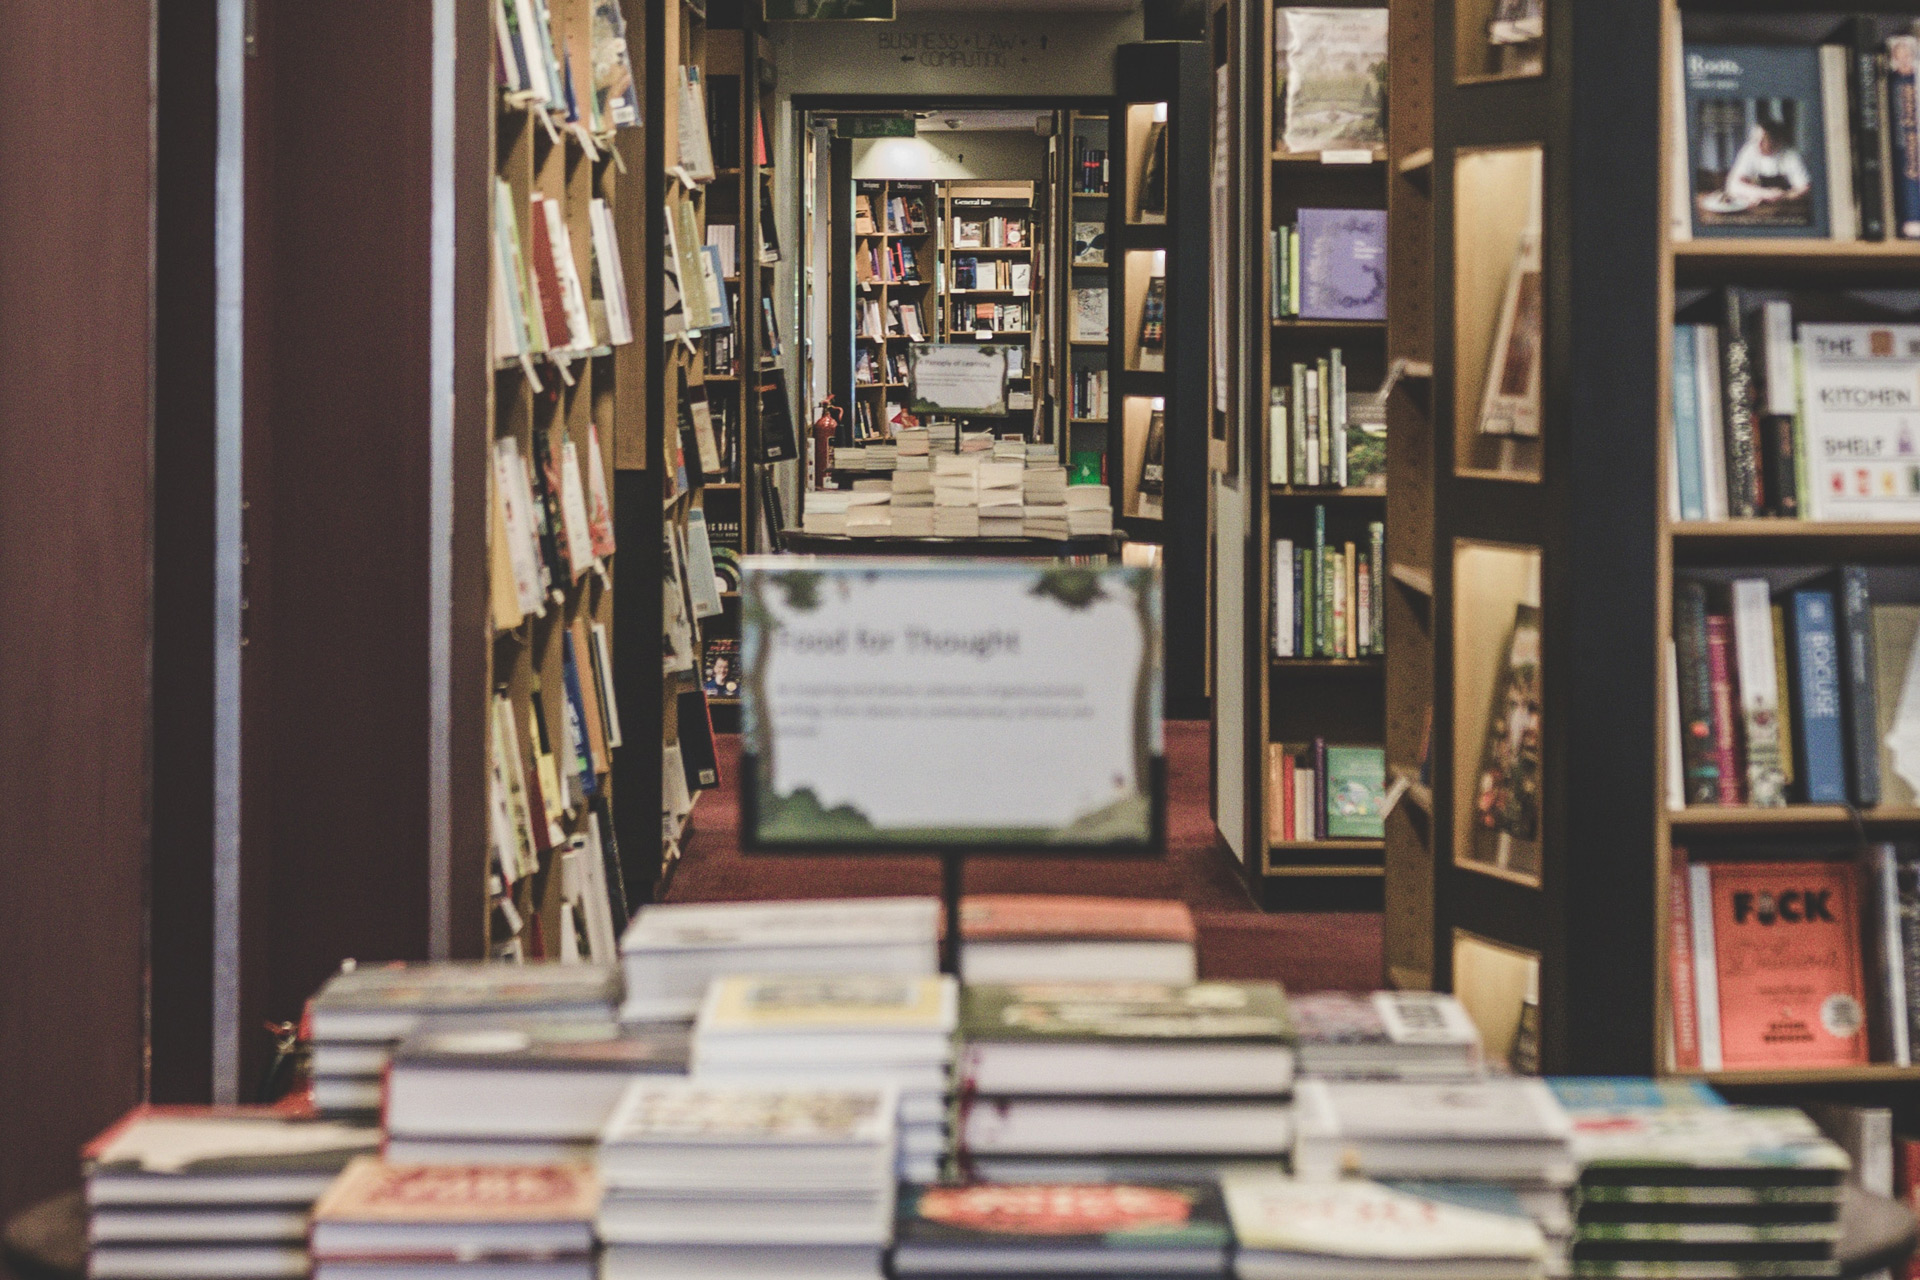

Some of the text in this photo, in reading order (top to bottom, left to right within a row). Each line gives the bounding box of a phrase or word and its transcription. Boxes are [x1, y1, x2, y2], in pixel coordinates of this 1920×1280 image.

[878, 31, 1018, 50] BUSINESS LAW
[954, 198, 992, 206] General law
[1815, 336, 1855, 356] THE
[1820, 387, 1912, 405] KITCHEN
[1824, 437, 1884, 456] SHELF
[855, 626, 894, 655] for
[903, 625, 1022, 662] Thought
